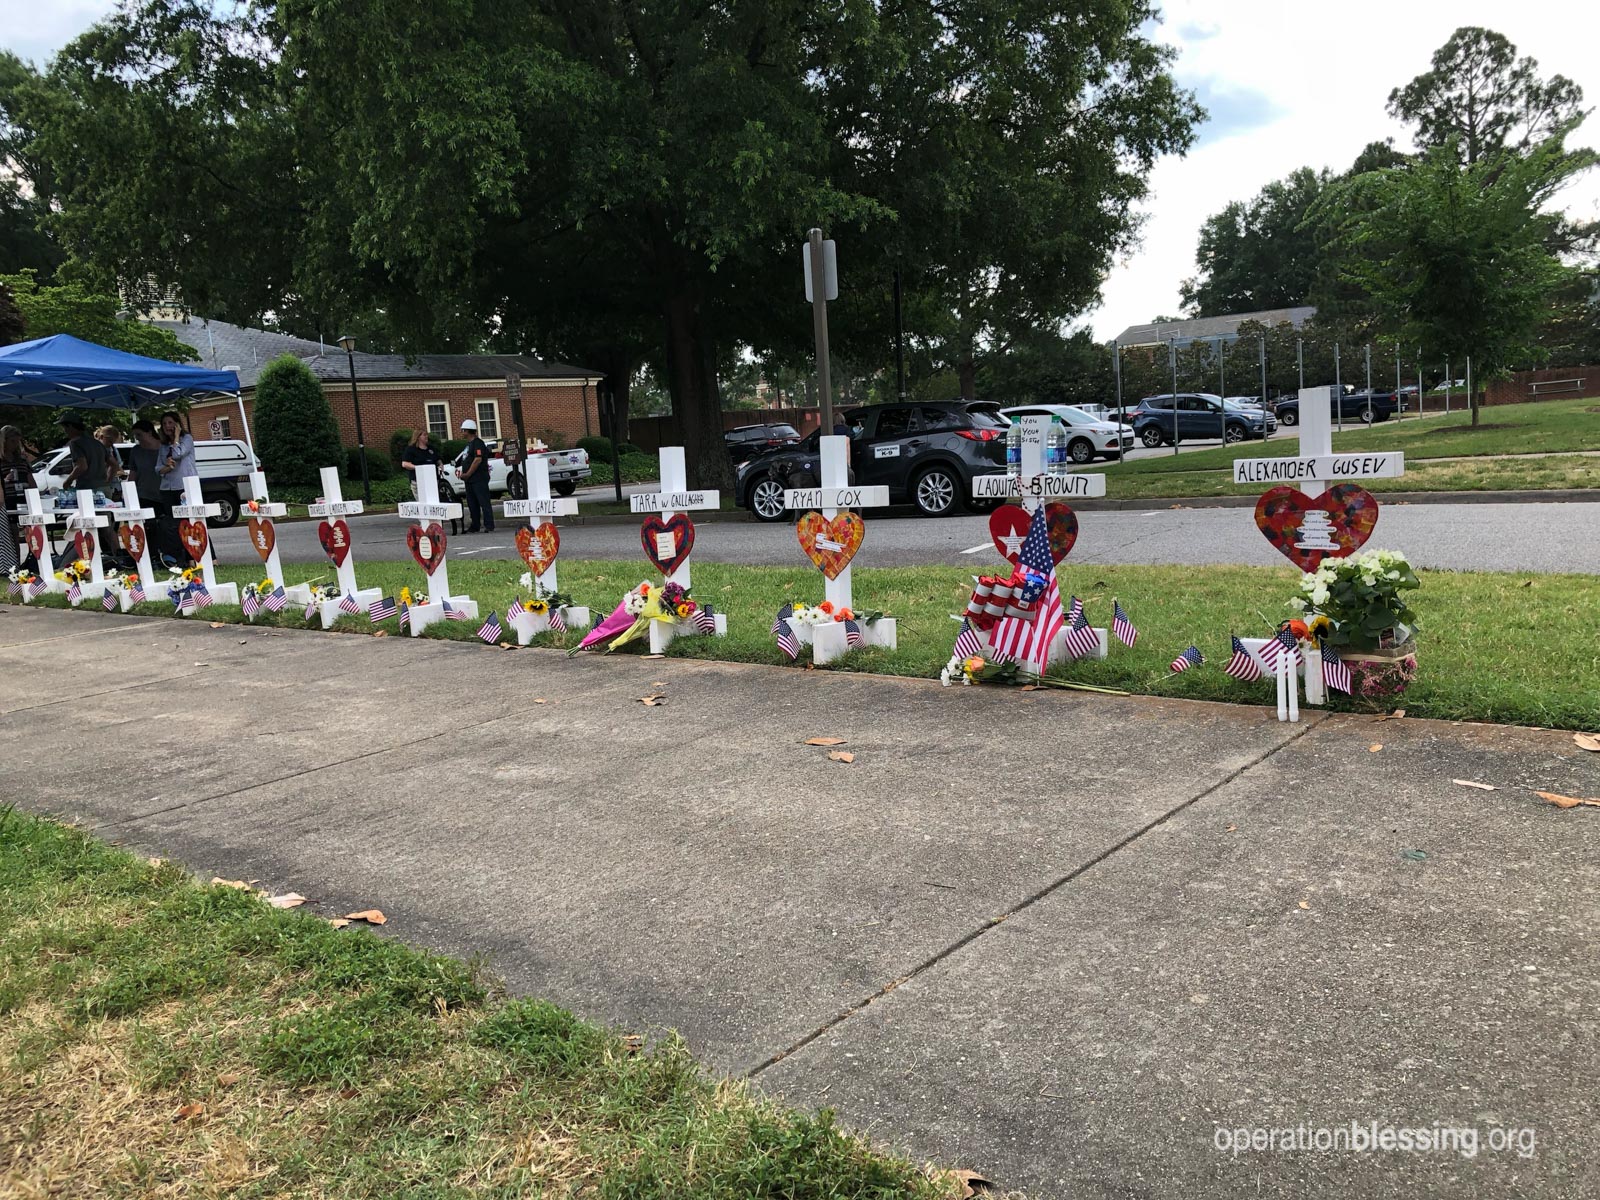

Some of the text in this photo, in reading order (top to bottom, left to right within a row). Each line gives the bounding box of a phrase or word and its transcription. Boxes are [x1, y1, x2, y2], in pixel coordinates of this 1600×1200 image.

[1238, 457, 1386, 482] ALEXANDER GUSEV
[1030, 476, 1088, 495] BROWN
[506, 501, 526, 515] MARY
[535, 500, 557, 514] GAYLE
[632, 493, 658, 512] TARA
[792, 489, 862, 508] RYAN COX
[400, 504, 419, 517] JOSHUA
